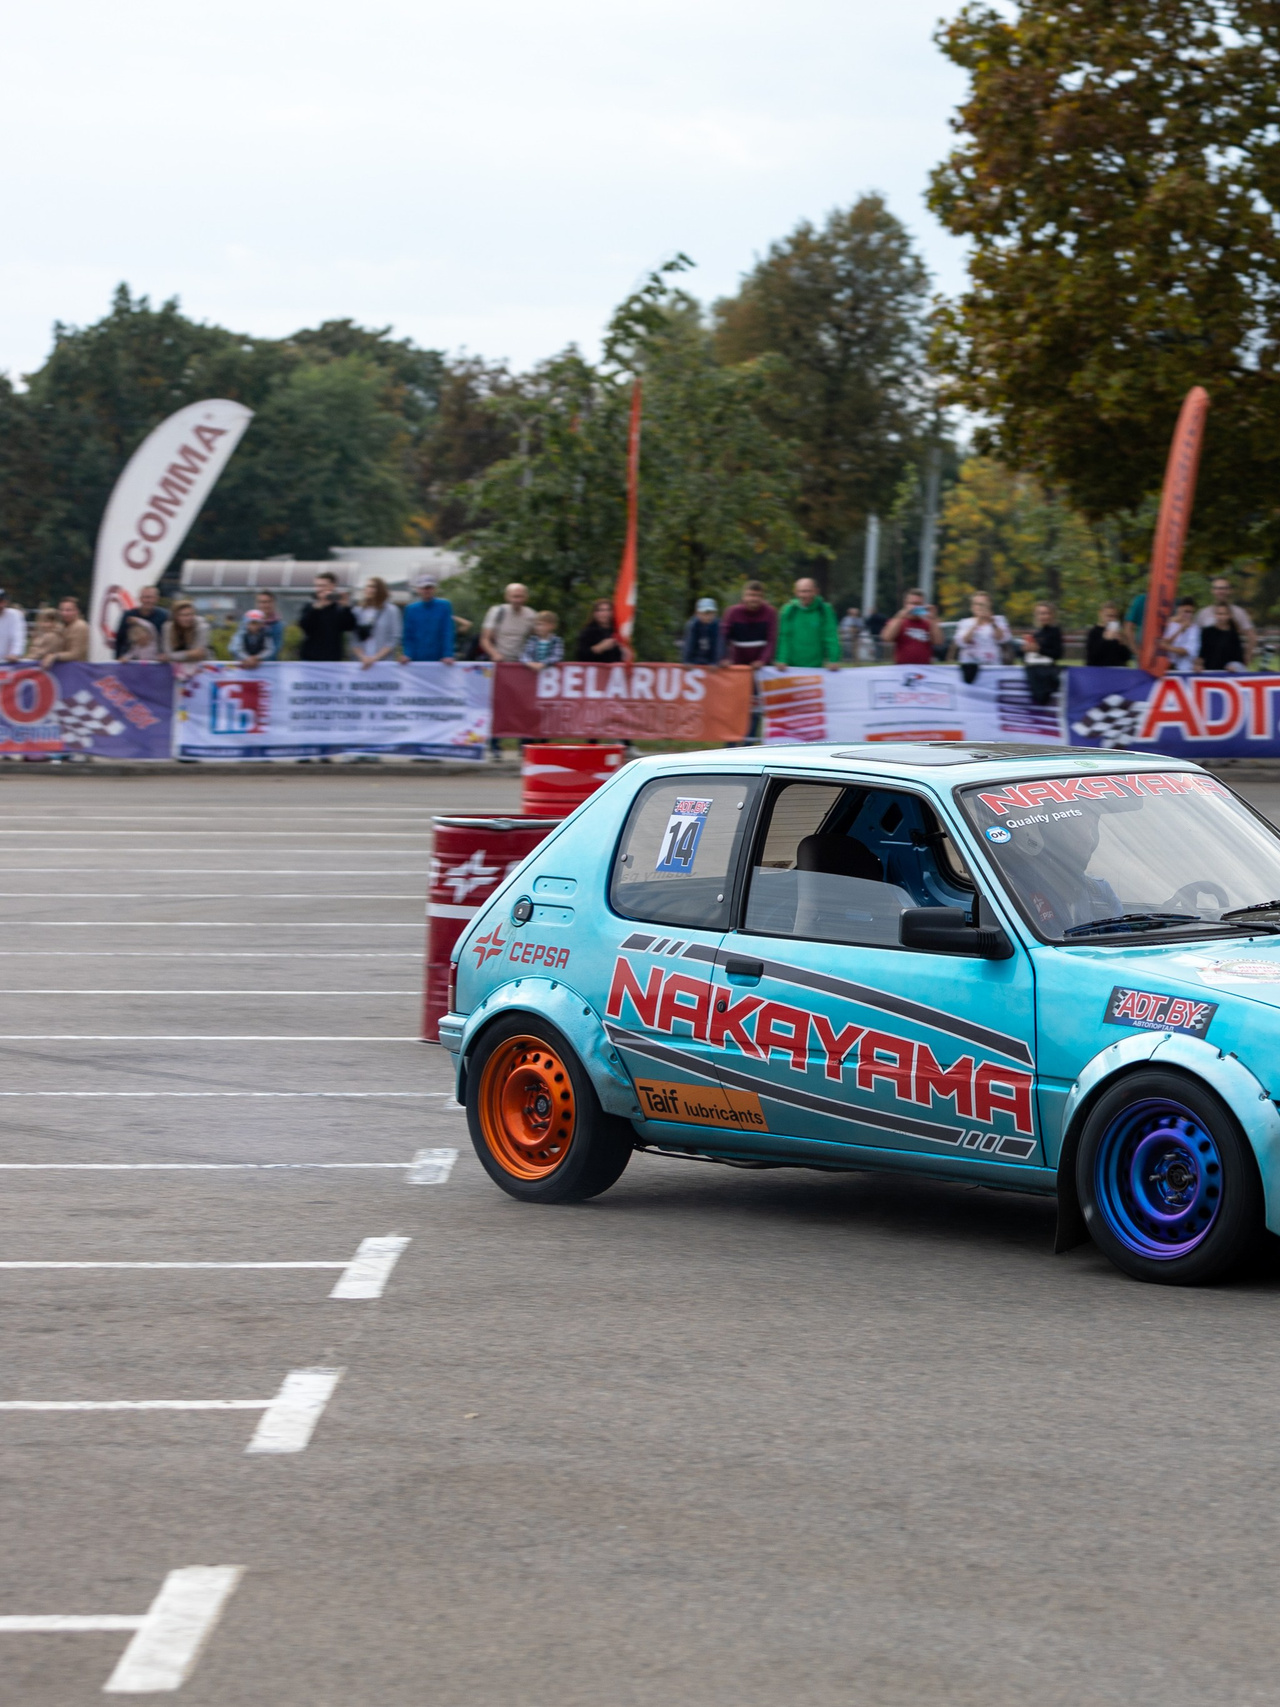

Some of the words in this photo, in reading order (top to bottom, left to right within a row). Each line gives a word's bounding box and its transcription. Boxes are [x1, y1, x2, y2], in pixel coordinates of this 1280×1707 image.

[123, 424, 228, 571] COMMA
[536, 666, 706, 701] BELARUS
[675, 801, 707, 813] ADT.BY
[978, 773, 1232, 816] NAKAYAMA
[991, 830, 1006, 839] OK
[1006, 813, 1050, 829] Quality
[1052, 808, 1083, 821] parts
[664, 821, 700, 867] 14
[509, 942, 570, 969] CEPSA
[1115, 990, 1207, 1028] ADT.BY
[1132, 1020, 1174, 1031] АВТОПОРТАЛ
[605, 956, 1035, 1136] NAKAYAMA
[639, 1086, 679, 1114] Taif
[683, 1101, 764, 1125] lubricants
